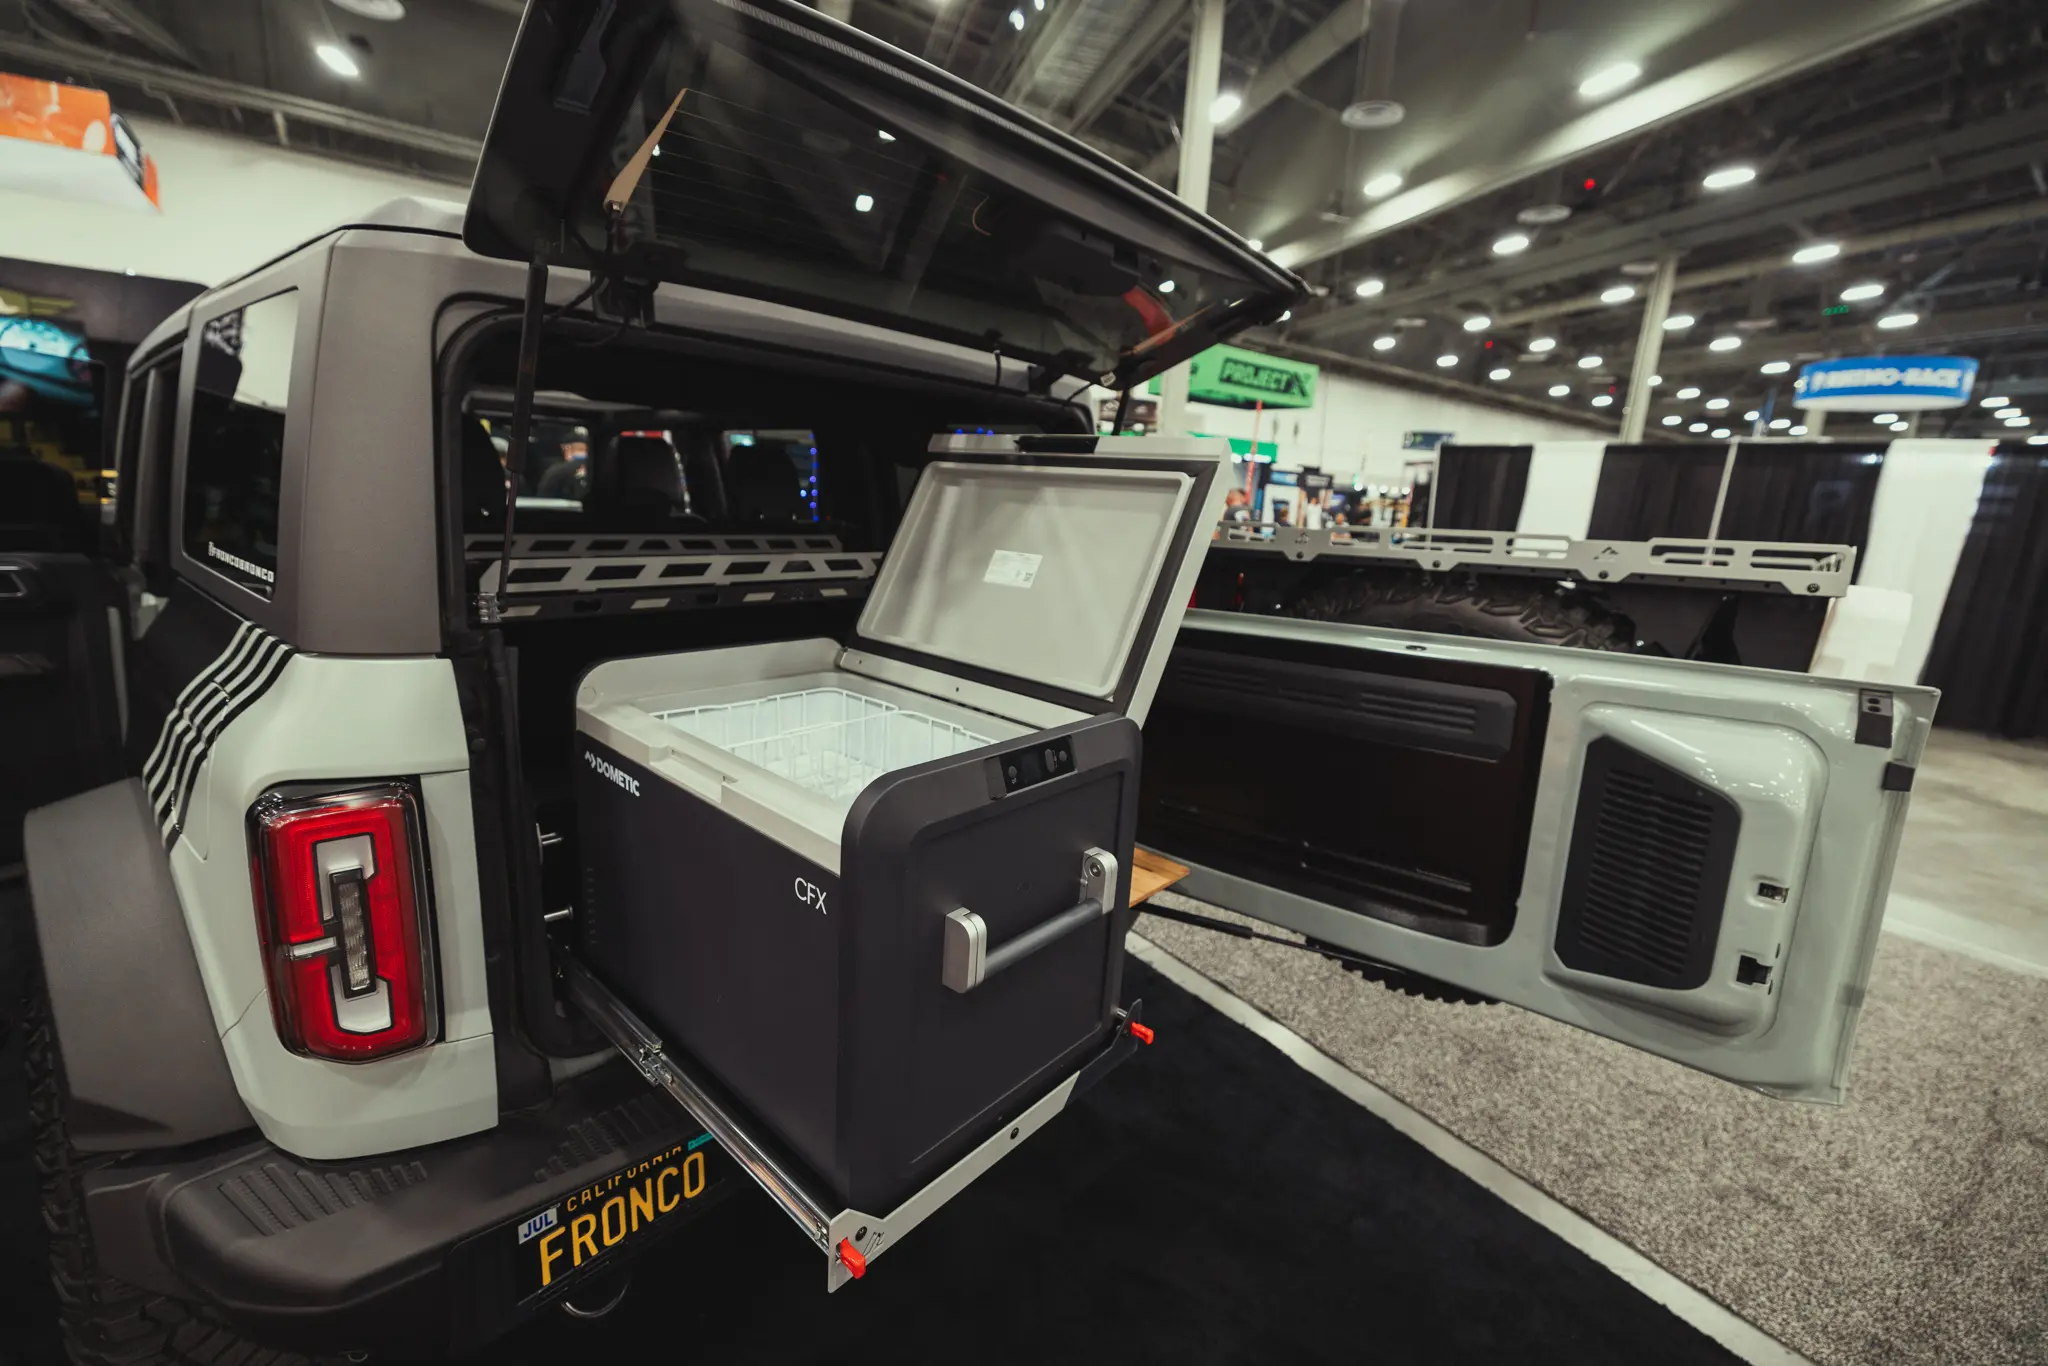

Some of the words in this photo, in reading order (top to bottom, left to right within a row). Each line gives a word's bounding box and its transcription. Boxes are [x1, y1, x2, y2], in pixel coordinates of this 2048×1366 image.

[596, 756, 640, 797] DOMETIC
[794, 877, 827, 915] CFX
[522, 1213, 554, 1240] JUL
[539, 1151, 706, 1287] FRONCO
